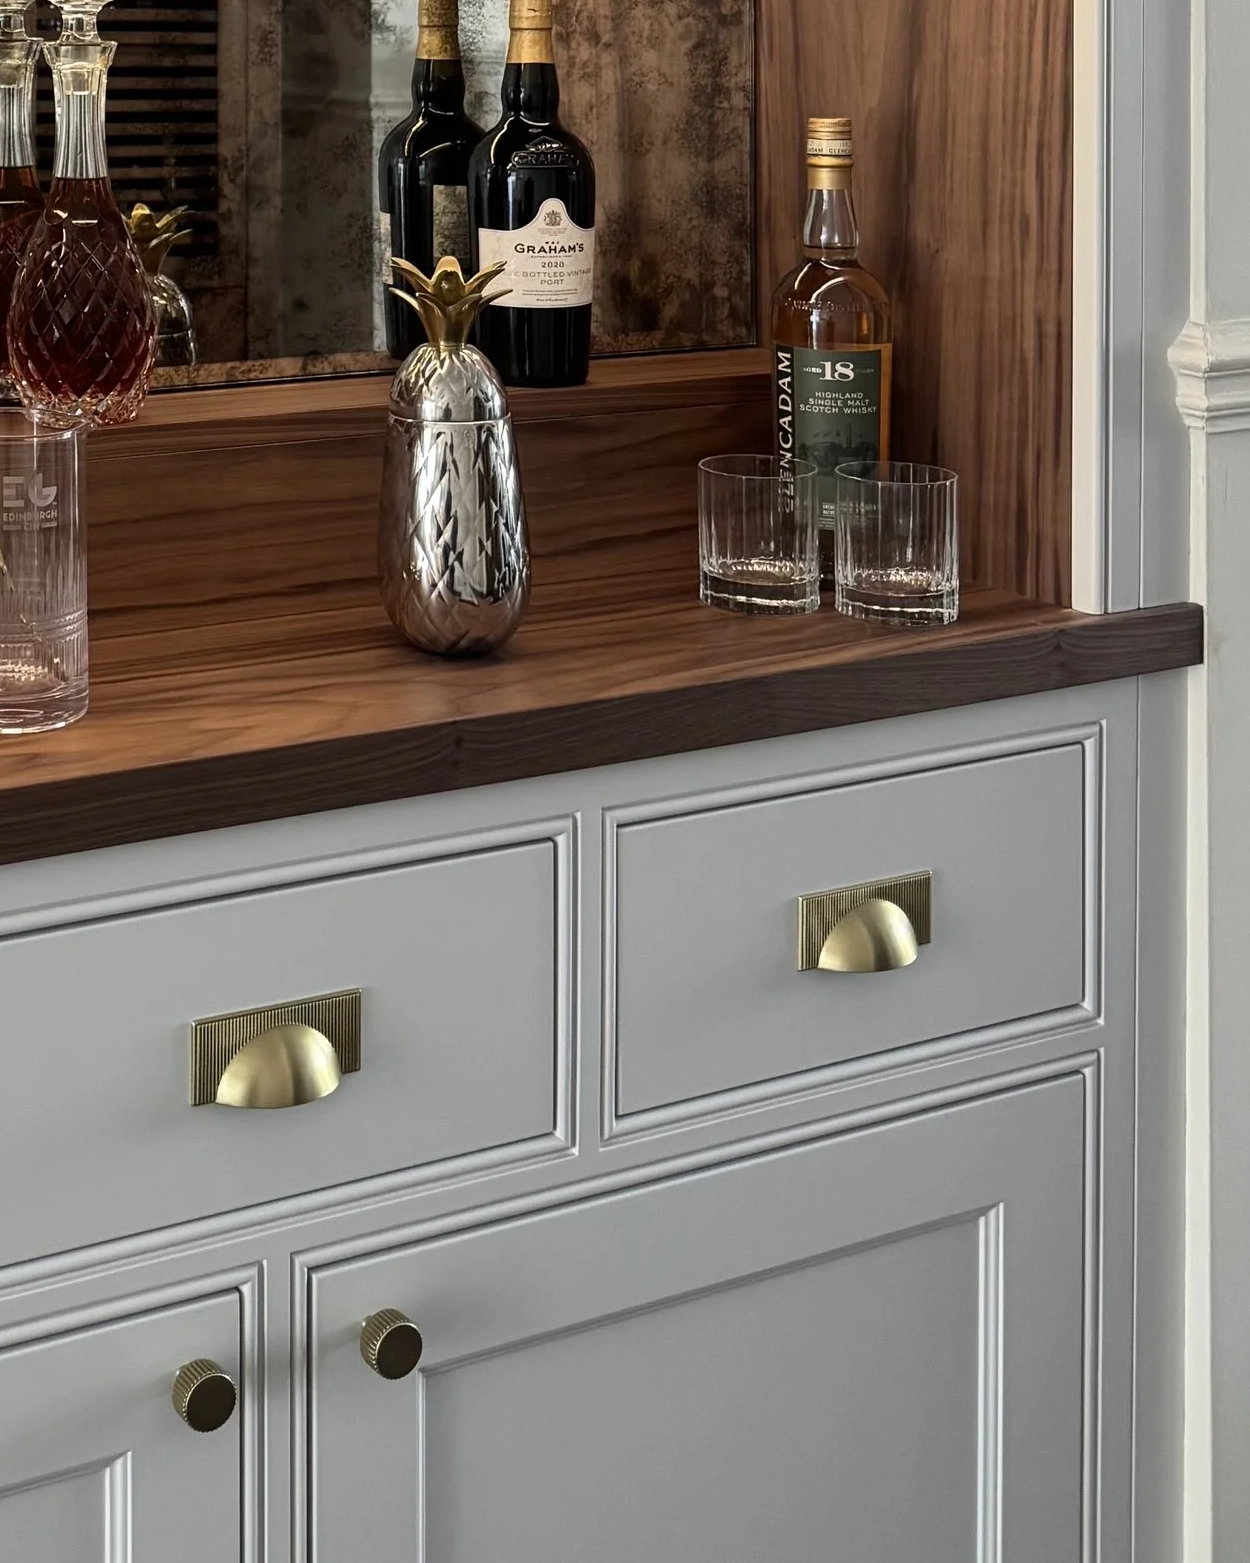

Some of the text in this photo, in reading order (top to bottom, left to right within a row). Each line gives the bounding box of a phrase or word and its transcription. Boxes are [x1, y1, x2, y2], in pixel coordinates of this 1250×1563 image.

[514, 242, 585, 254] GRAHAM'S
[541, 261, 565, 269] 2020
[522, 270, 565, 278] BOTTLED
[818, 360, 855, 382] 18
[815, 391, 864, 399] HIGHLAND
[808, 397, 870, 407] SINGLE MALT
[799, 403, 878, 414] SCOTCH WHISKY
